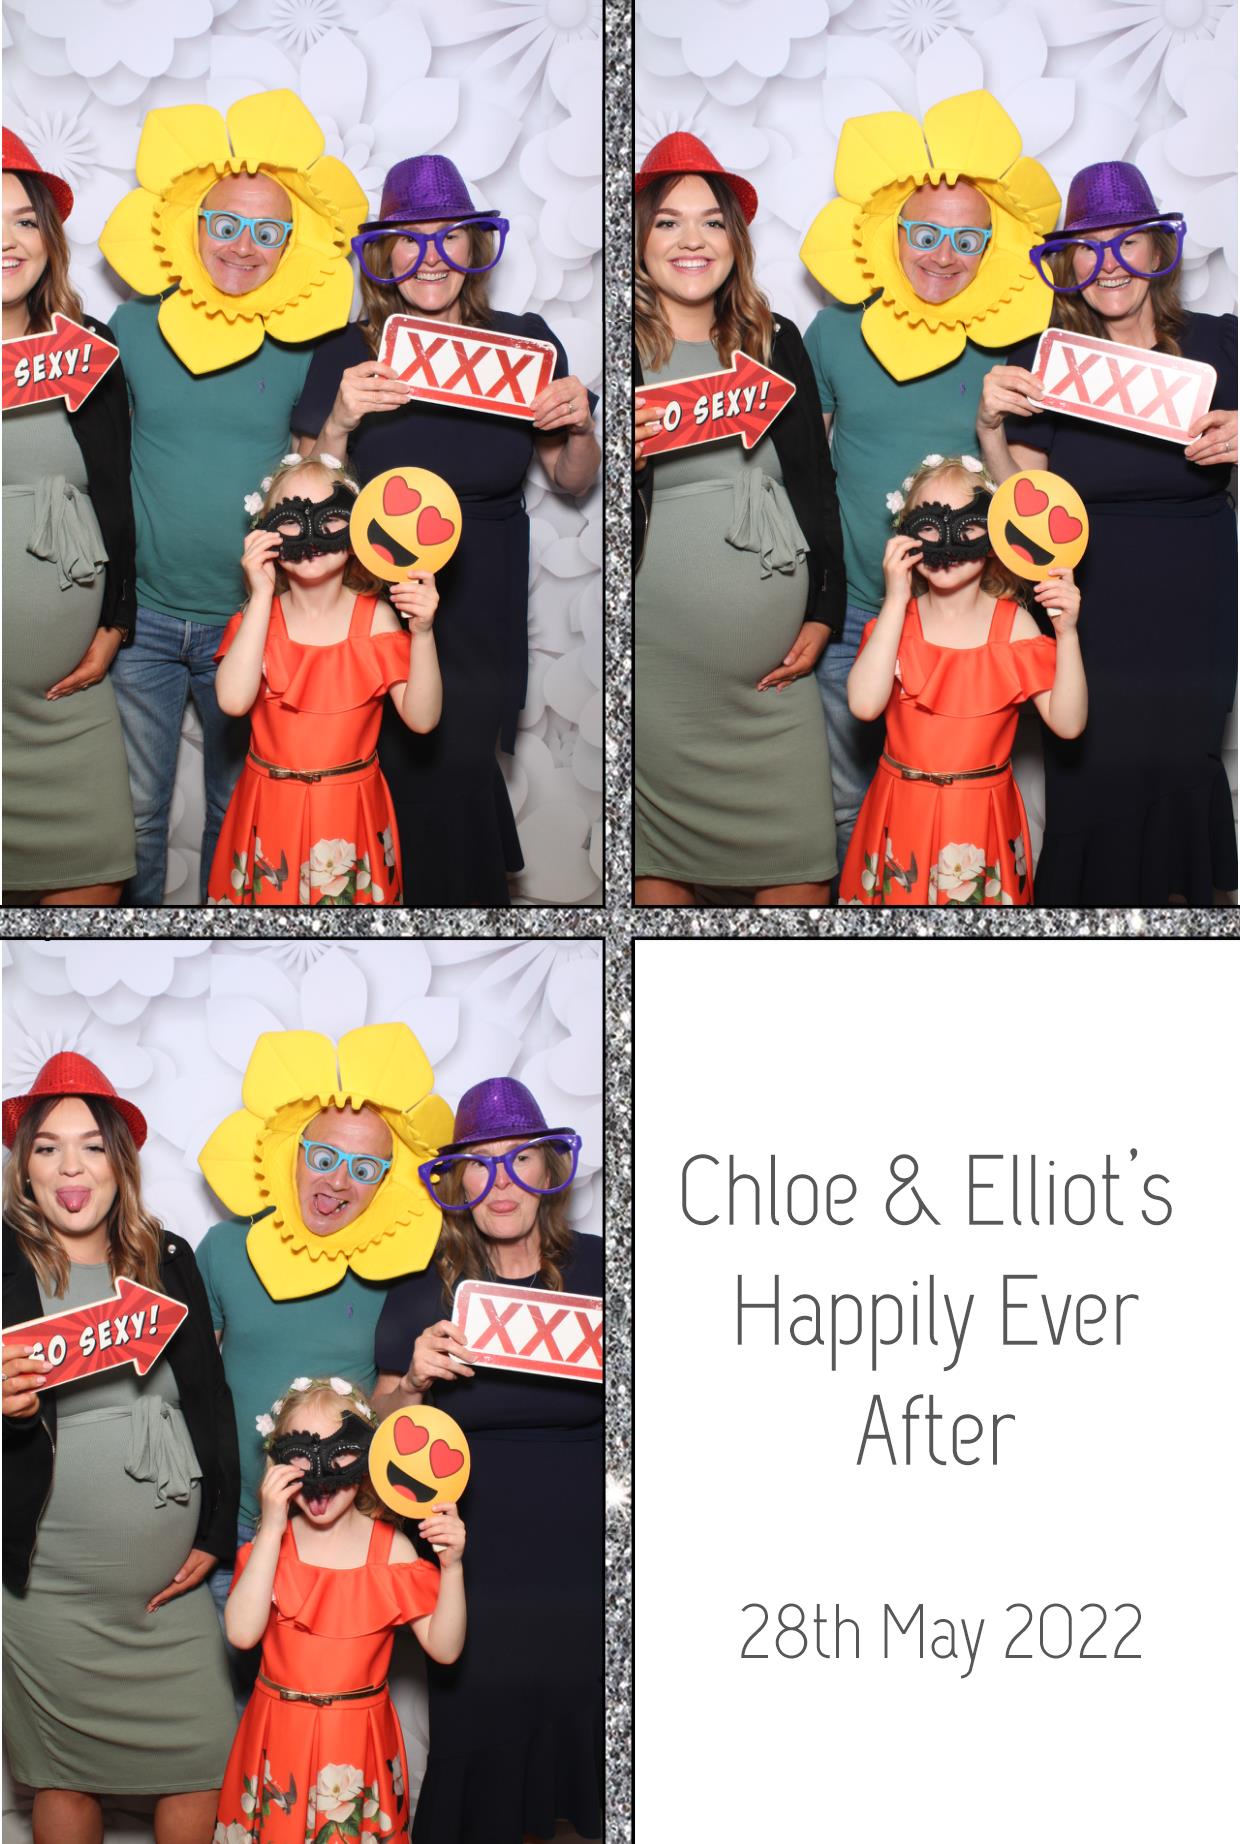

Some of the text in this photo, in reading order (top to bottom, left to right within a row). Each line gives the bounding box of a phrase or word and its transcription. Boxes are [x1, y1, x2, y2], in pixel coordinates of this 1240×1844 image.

[14, 343, 93, 388] SEXY!
[398, 331, 536, 405] XXX
[1048, 345, 1193, 428] XXX
[693, 380, 771, 426] SEXY!
[79, 1304, 160, 1357] SEXY!
[471, 1297, 603, 1368] XXX
